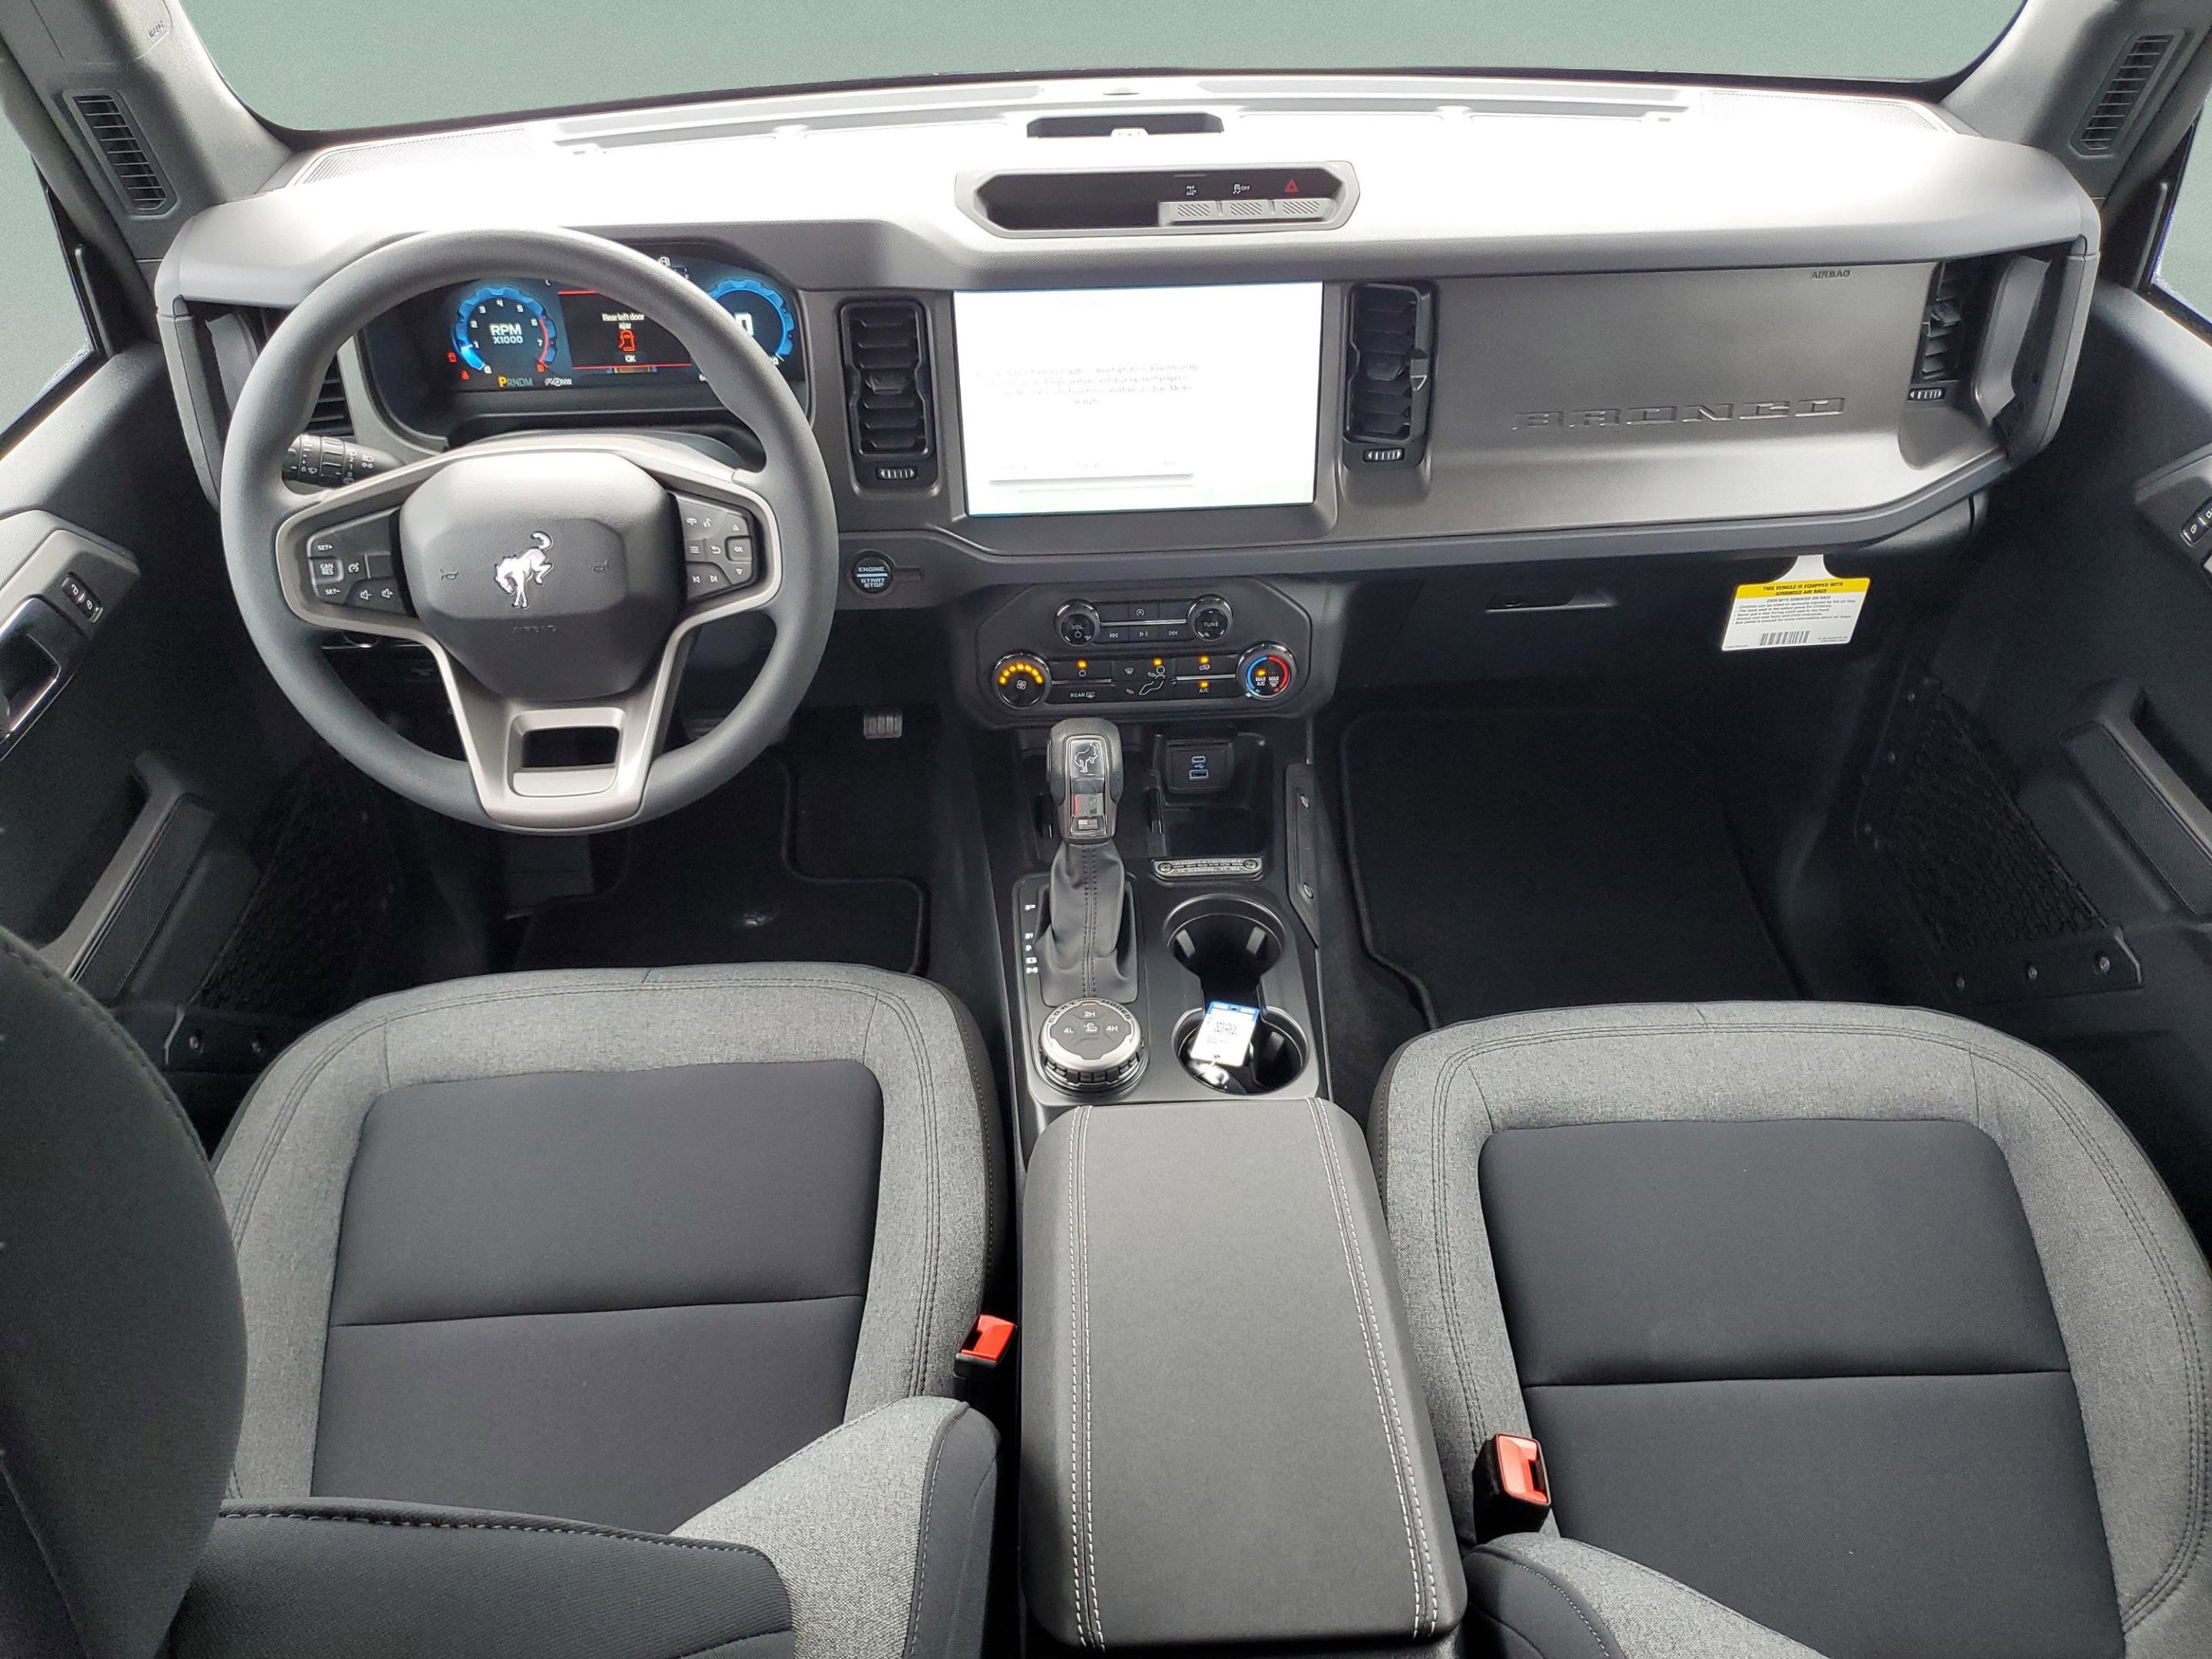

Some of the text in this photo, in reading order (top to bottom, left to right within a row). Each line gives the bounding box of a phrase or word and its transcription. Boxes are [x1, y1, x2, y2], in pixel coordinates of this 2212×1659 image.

[1810, 270, 1850, 280] AIRBAG
[601, 313, 618, 321] Rear
[618, 313, 629, 321] left
[489, 323, 523, 336] RPM
[493, 335, 523, 344] X1000
[484, 366, 492, 374] 0
[1512, 397, 1846, 430] BRONCO
[1101, 1000, 1132, 1020] MODES
